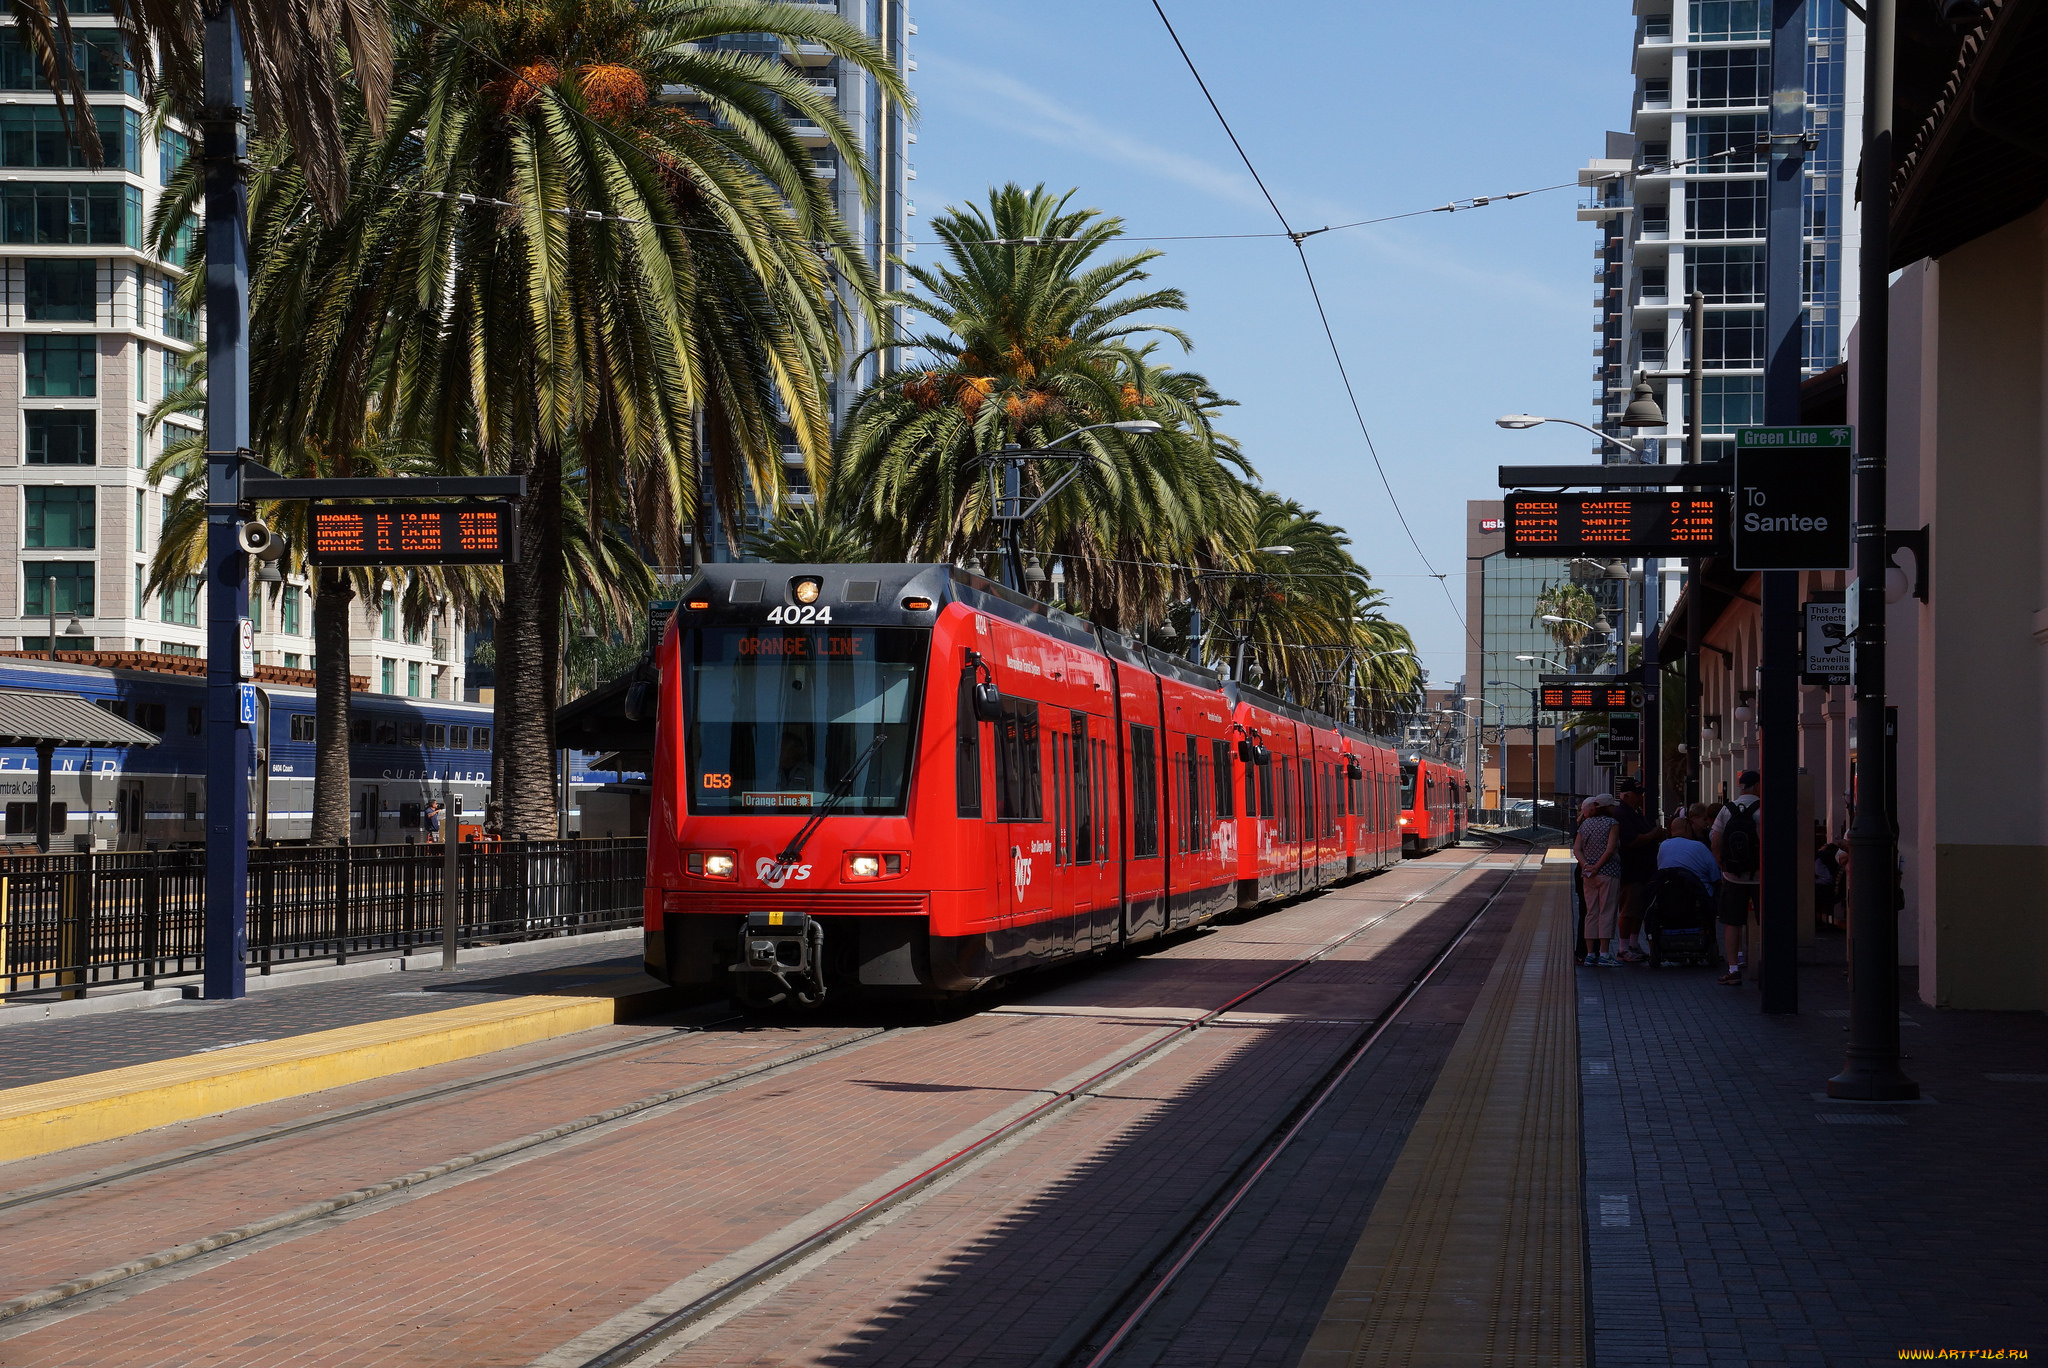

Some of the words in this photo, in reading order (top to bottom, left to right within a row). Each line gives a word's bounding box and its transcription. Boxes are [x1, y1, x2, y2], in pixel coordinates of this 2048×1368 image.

[1744, 430, 1784, 445] Green
[1788, 430, 1818, 444] Line
[1743, 487, 1766, 507] To
[1515, 502, 1558, 514] GREEN
[1581, 502, 1631, 514] SANTEE
[1691, 501, 1713, 513] MIN
[1743, 512, 1828, 532] Santee
[1515, 529, 1558, 541] GREEN
[1581, 529, 1631, 541] SANTEE
[1691, 528, 1713, 541] MIN
[766, 605, 832, 625] 4024
[1810, 606, 1829, 614] This
[738, 637, 807, 655] ORANGE
[817, 637, 863, 655] LINE
[703, 773, 732, 789] 053
[745, 794, 776, 807] Orange
[778, 795, 798, 807] Line
[756, 864, 813, 880] MTS
